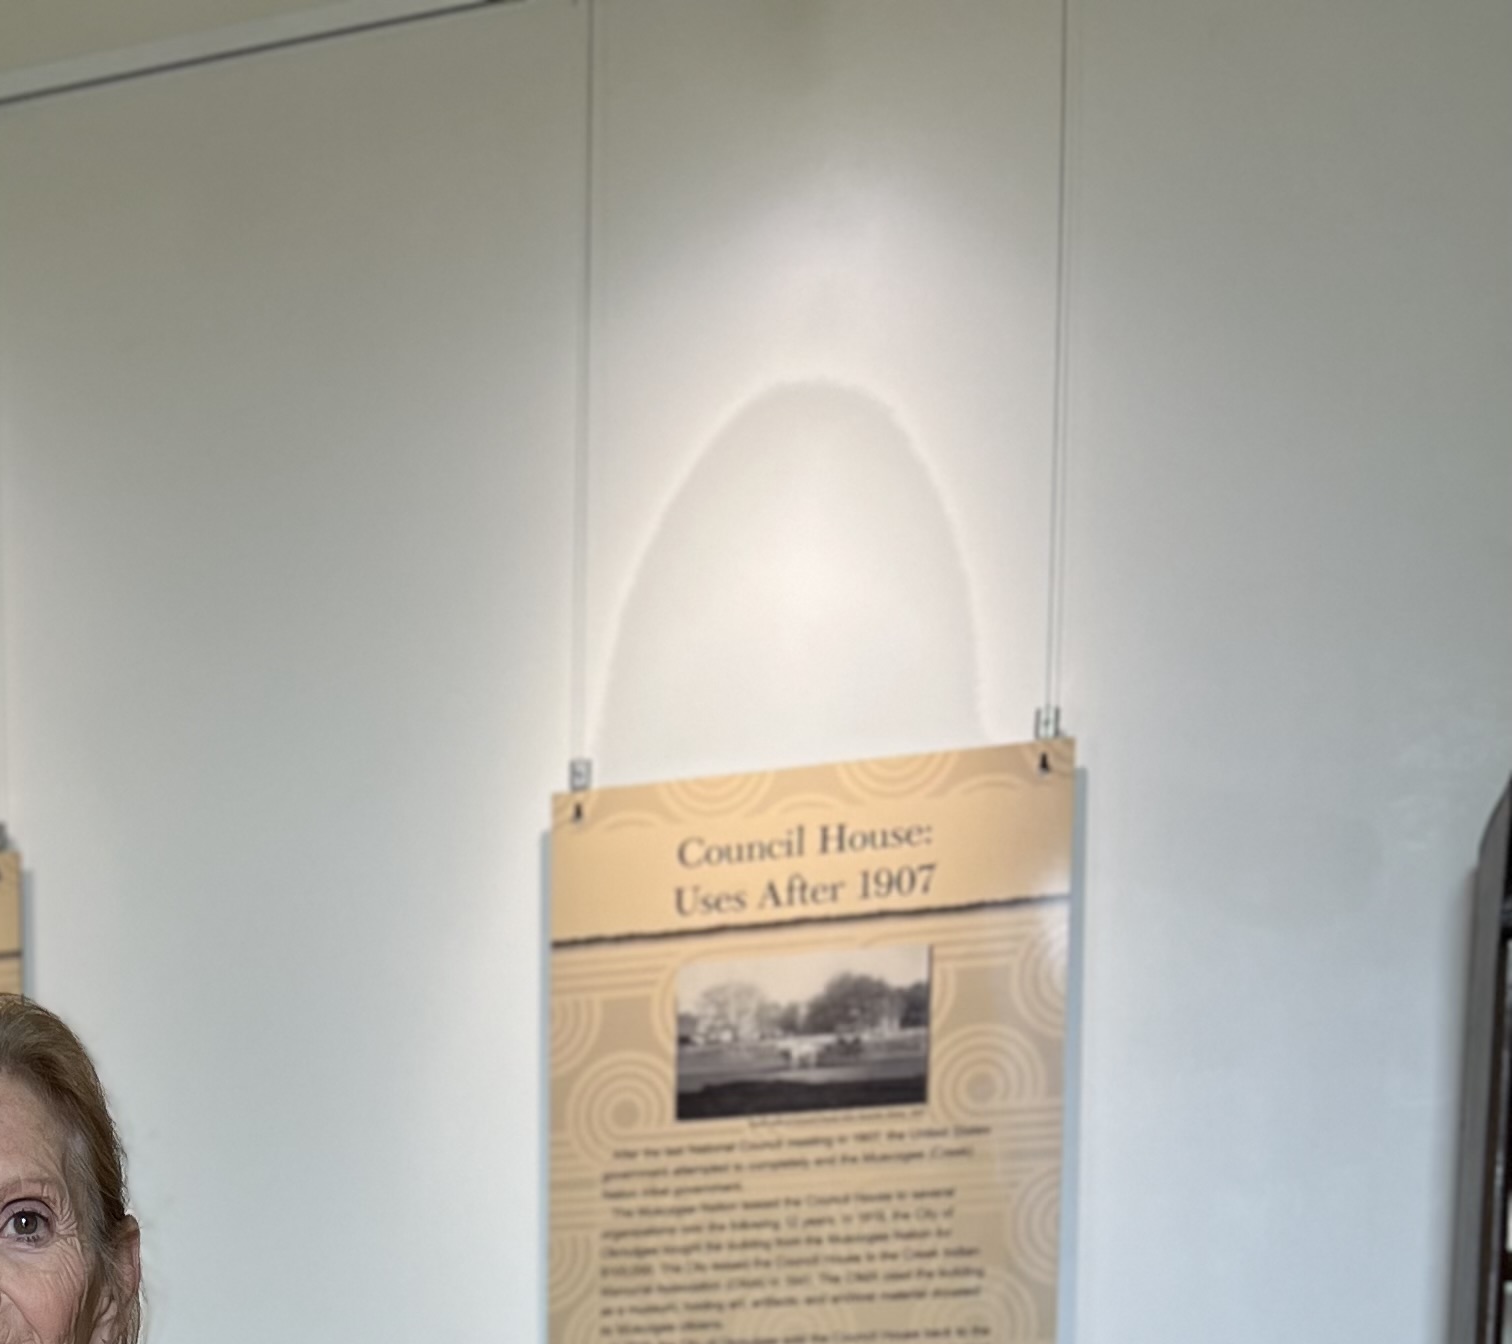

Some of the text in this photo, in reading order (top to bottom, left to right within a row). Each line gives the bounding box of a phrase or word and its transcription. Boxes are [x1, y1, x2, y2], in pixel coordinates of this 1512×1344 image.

[677, 823, 933, 869] Council House:
[674, 862, 936, 917] Uses After 1907
